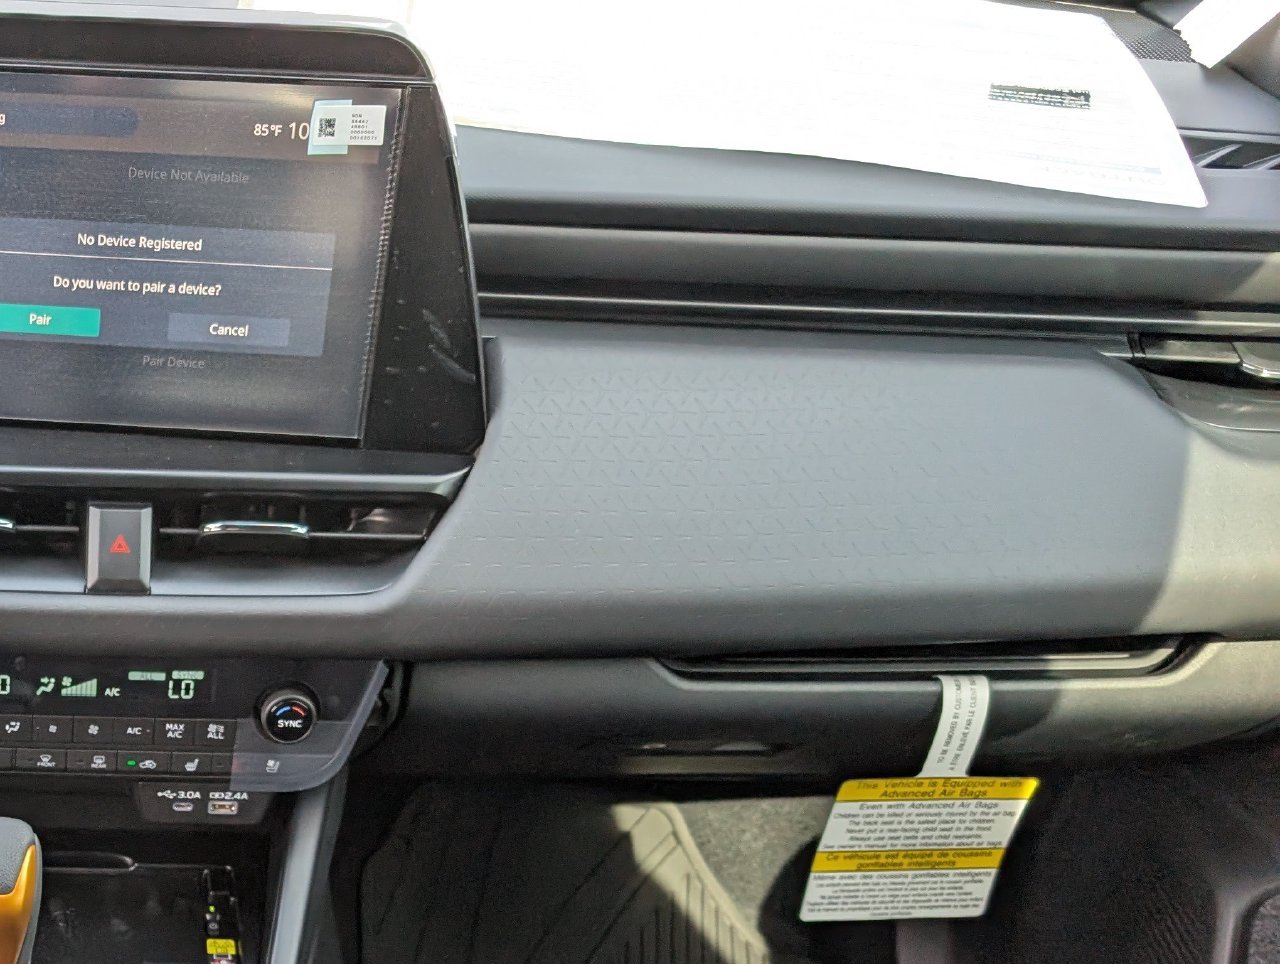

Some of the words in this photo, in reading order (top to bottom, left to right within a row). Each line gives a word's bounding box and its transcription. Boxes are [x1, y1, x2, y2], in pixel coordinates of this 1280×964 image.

[128, 167, 168, 180] Device
[170, 169, 192, 181] Not
[195, 170, 250, 184] Available
[77, 233, 94, 246] No
[97, 234, 136, 247] Device
[139, 236, 202, 252] Registered
[53, 275, 70, 288] Do
[71, 279, 93, 291] you
[96, 279, 125, 292] want
[128, 281, 140, 293] to
[142, 281, 166, 295] pair
[168, 284, 176, 294] a
[178, 283, 222, 296] device?
[29, 312, 52, 327] Pair
[209, 323, 249, 337] Cancel
[142, 355, 164, 367] Pair
[167, 356, 205, 369] Device
[104, 687, 120, 697] A/C
[168, 679, 194, 699] LO
[165, 723, 185, 731] MAX
[277, 719, 303, 728] SYNC
[126, 727, 142, 735] A/C
[167, 731, 183, 739] A/C
[207, 732, 224, 740] ALL
[858, 781, 878, 789] This
[885, 780, 924, 789] Vehicle
[928, 780, 937, 788] is
[942, 779, 996, 789] Equipped
[1000, 780, 1023, 788] with
[177, 790, 201, 799] 3.0A
[225, 791, 249, 800] 2.4A
[880, 789, 935, 798] Advanced
[940, 788, 955, 797] Air
[959, 787, 987, 799] Bags
[859, 802, 882, 810] Even
[959, 801, 971, 809] Air
[974, 801, 999, 810] Bags
[937, 851, 949, 859] de
